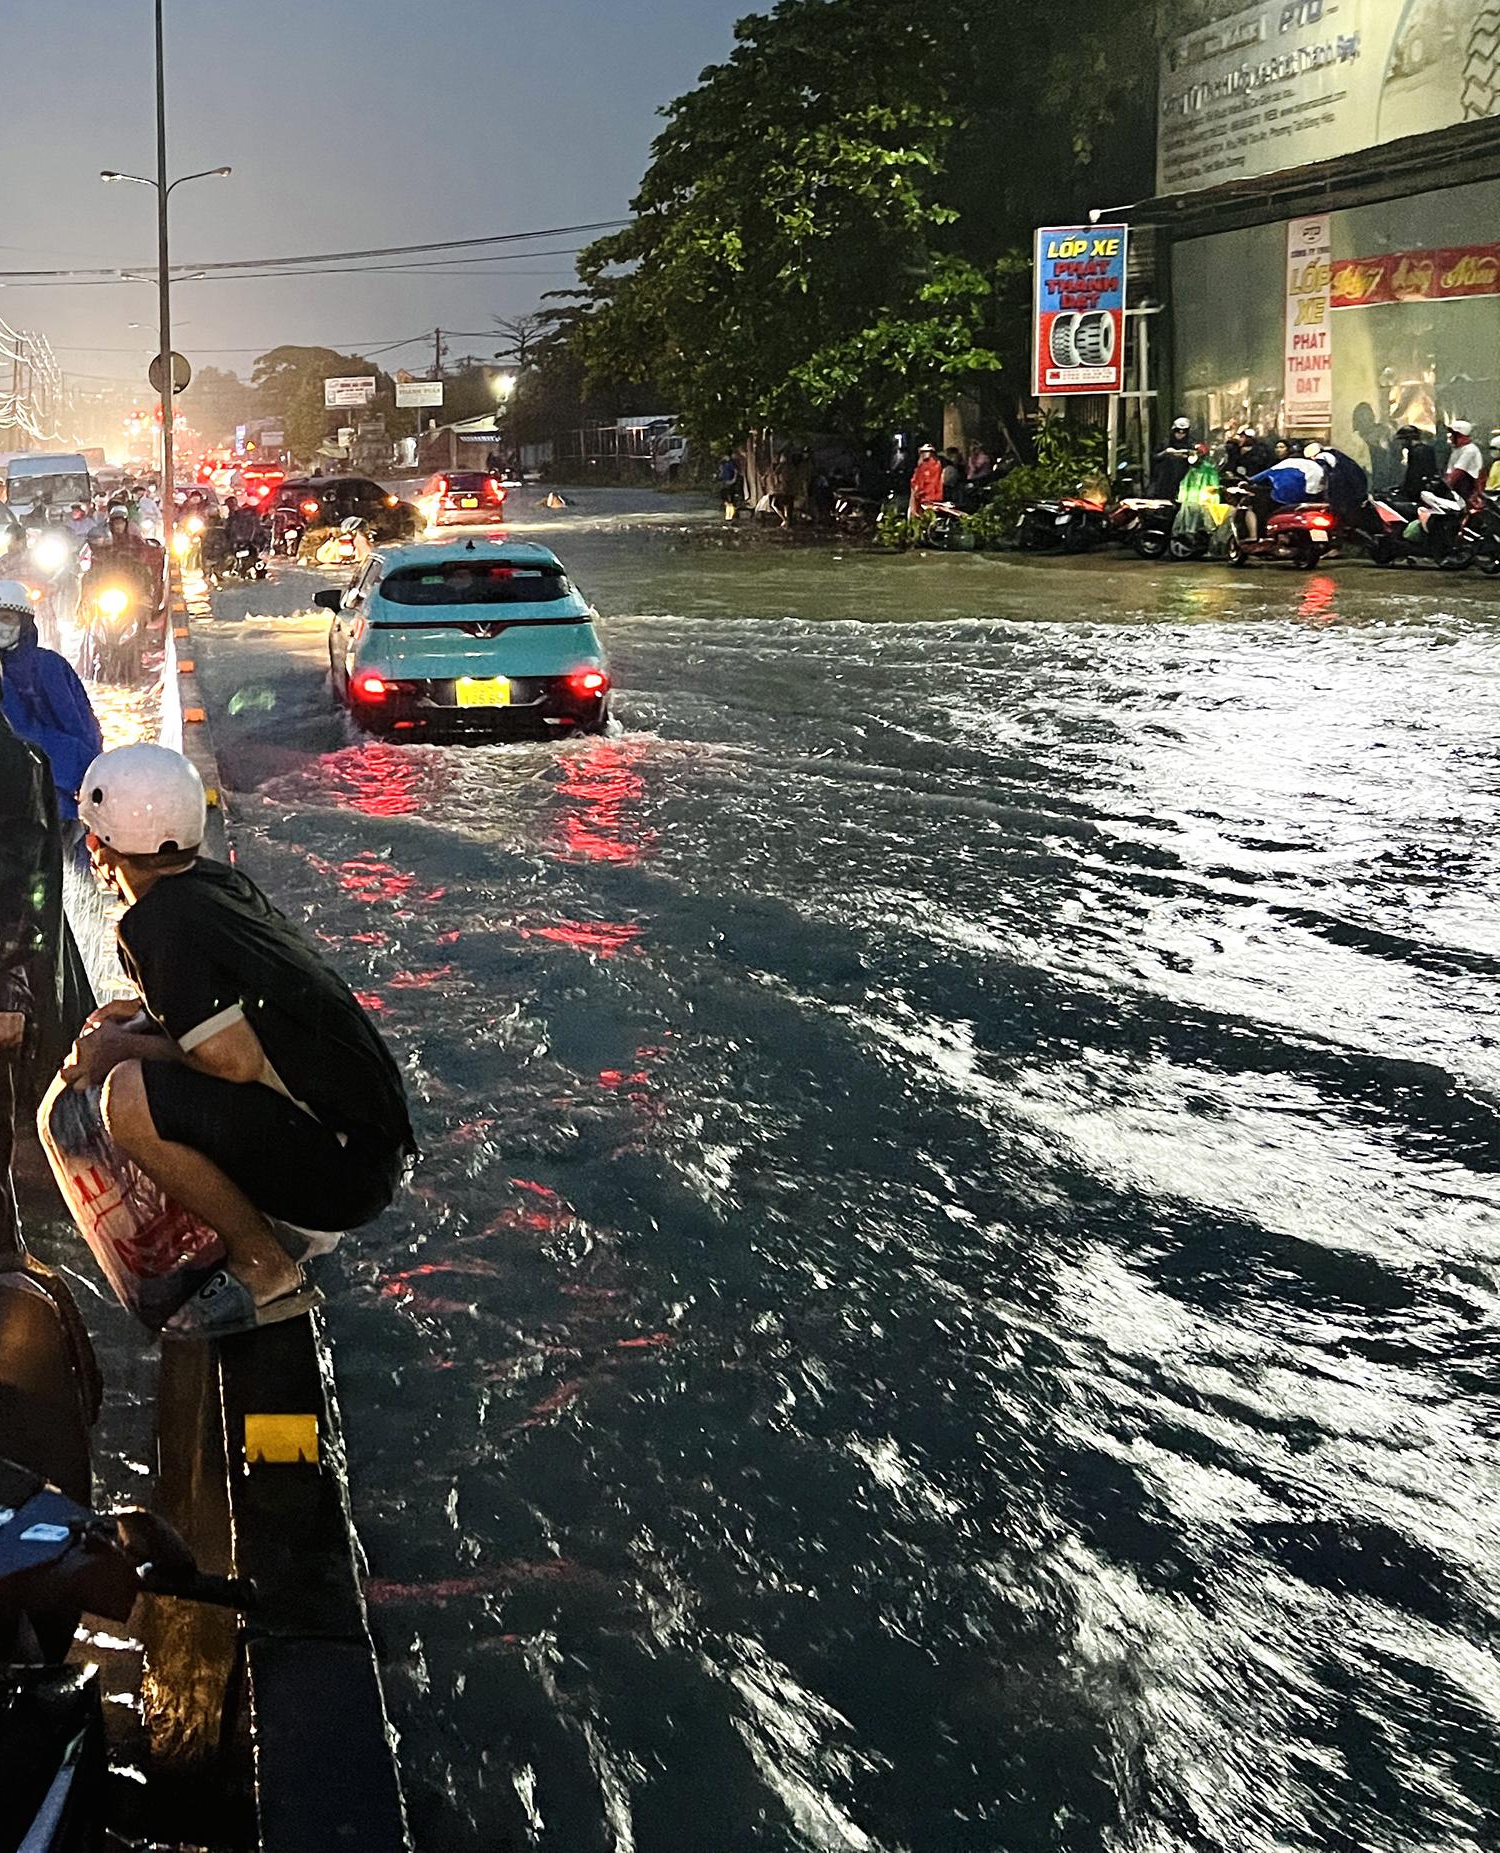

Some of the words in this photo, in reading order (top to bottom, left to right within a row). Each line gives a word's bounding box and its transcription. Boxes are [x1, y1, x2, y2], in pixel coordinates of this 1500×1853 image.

[1047, 235, 1088, 259] LỐP
[1090, 238, 1120, 257] XE
[1053, 256, 1112, 278] PHÁT
[1289, 256, 1334, 296] LỐP
[1296, 296, 1326, 327] XE
